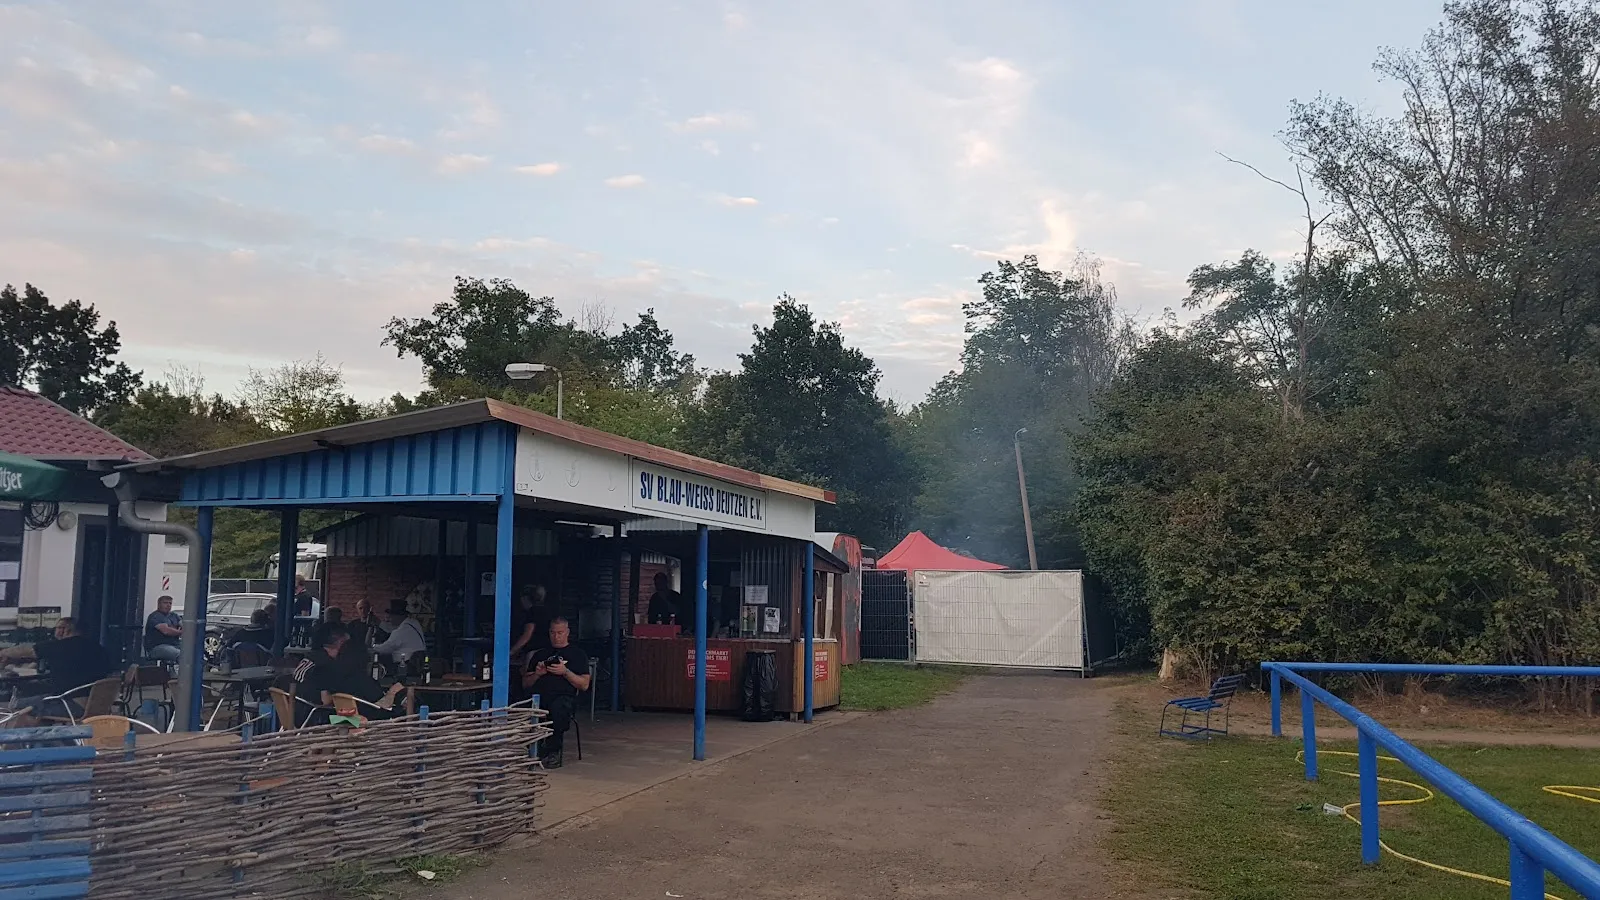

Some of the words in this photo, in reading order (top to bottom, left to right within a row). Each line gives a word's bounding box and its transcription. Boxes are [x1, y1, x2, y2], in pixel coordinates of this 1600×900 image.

[640, 471, 654, 500] SV
[657, 475, 714, 512] BLAU-WEISS
[716, 489, 748, 518] DEUTZEN
[750, 497, 763, 520] E.V.
